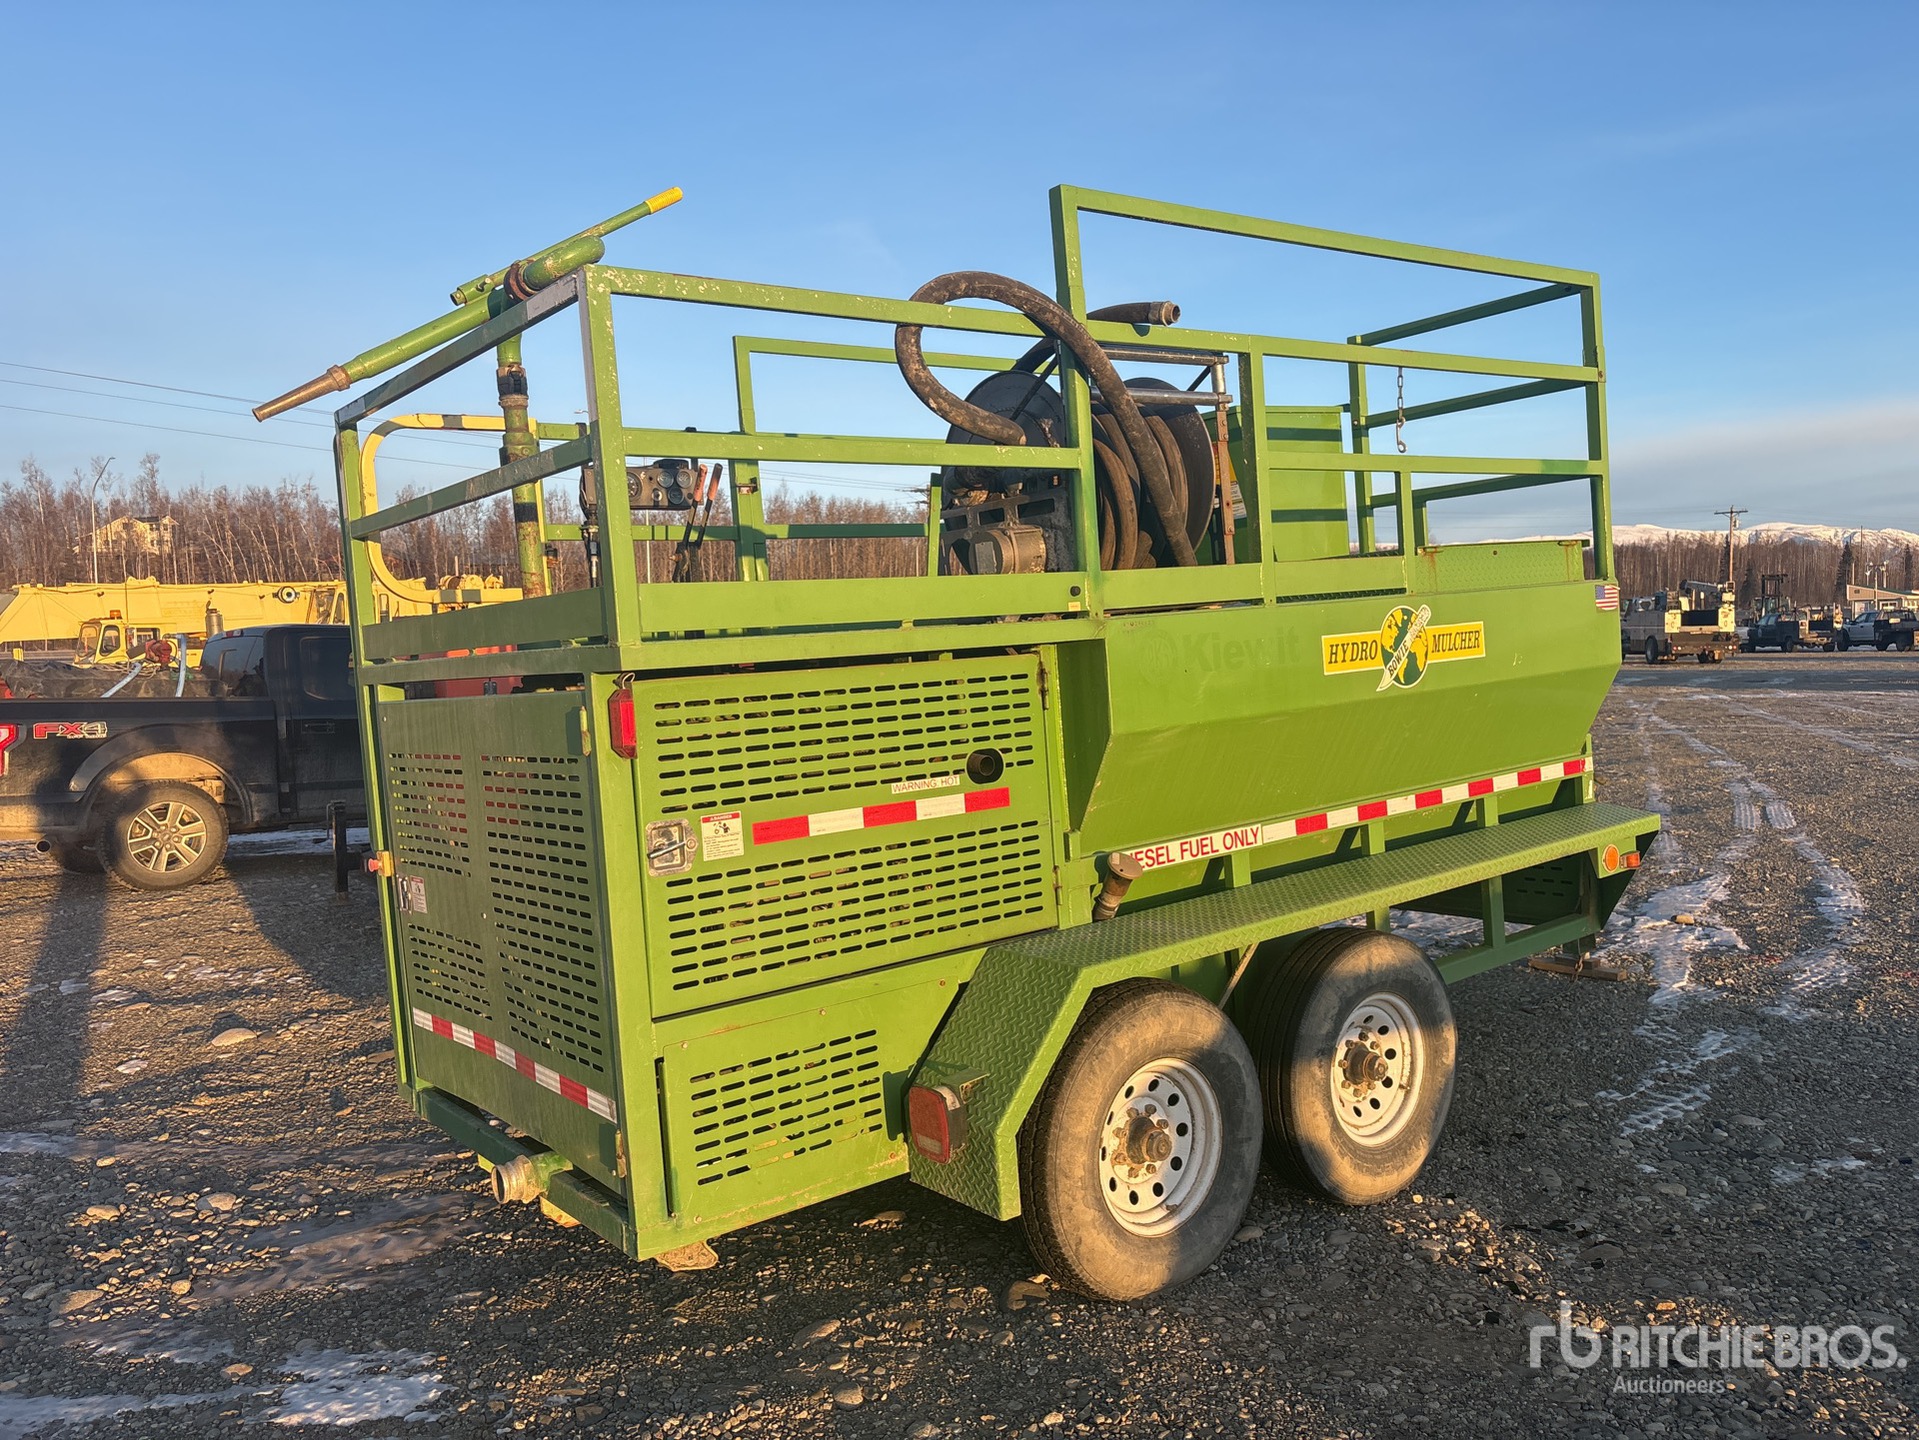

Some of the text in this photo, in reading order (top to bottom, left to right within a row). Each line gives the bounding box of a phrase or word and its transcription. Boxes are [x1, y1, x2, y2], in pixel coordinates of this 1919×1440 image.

[1328, 629, 1481, 665] HYDRO MULCHER
[1387, 640, 1409, 678] BOWIE
[33, 721, 108, 739] FX4
[892, 775, 959, 793] WARNING HOT
[1130, 826, 1260, 869] ESEL FUEL ONLY
